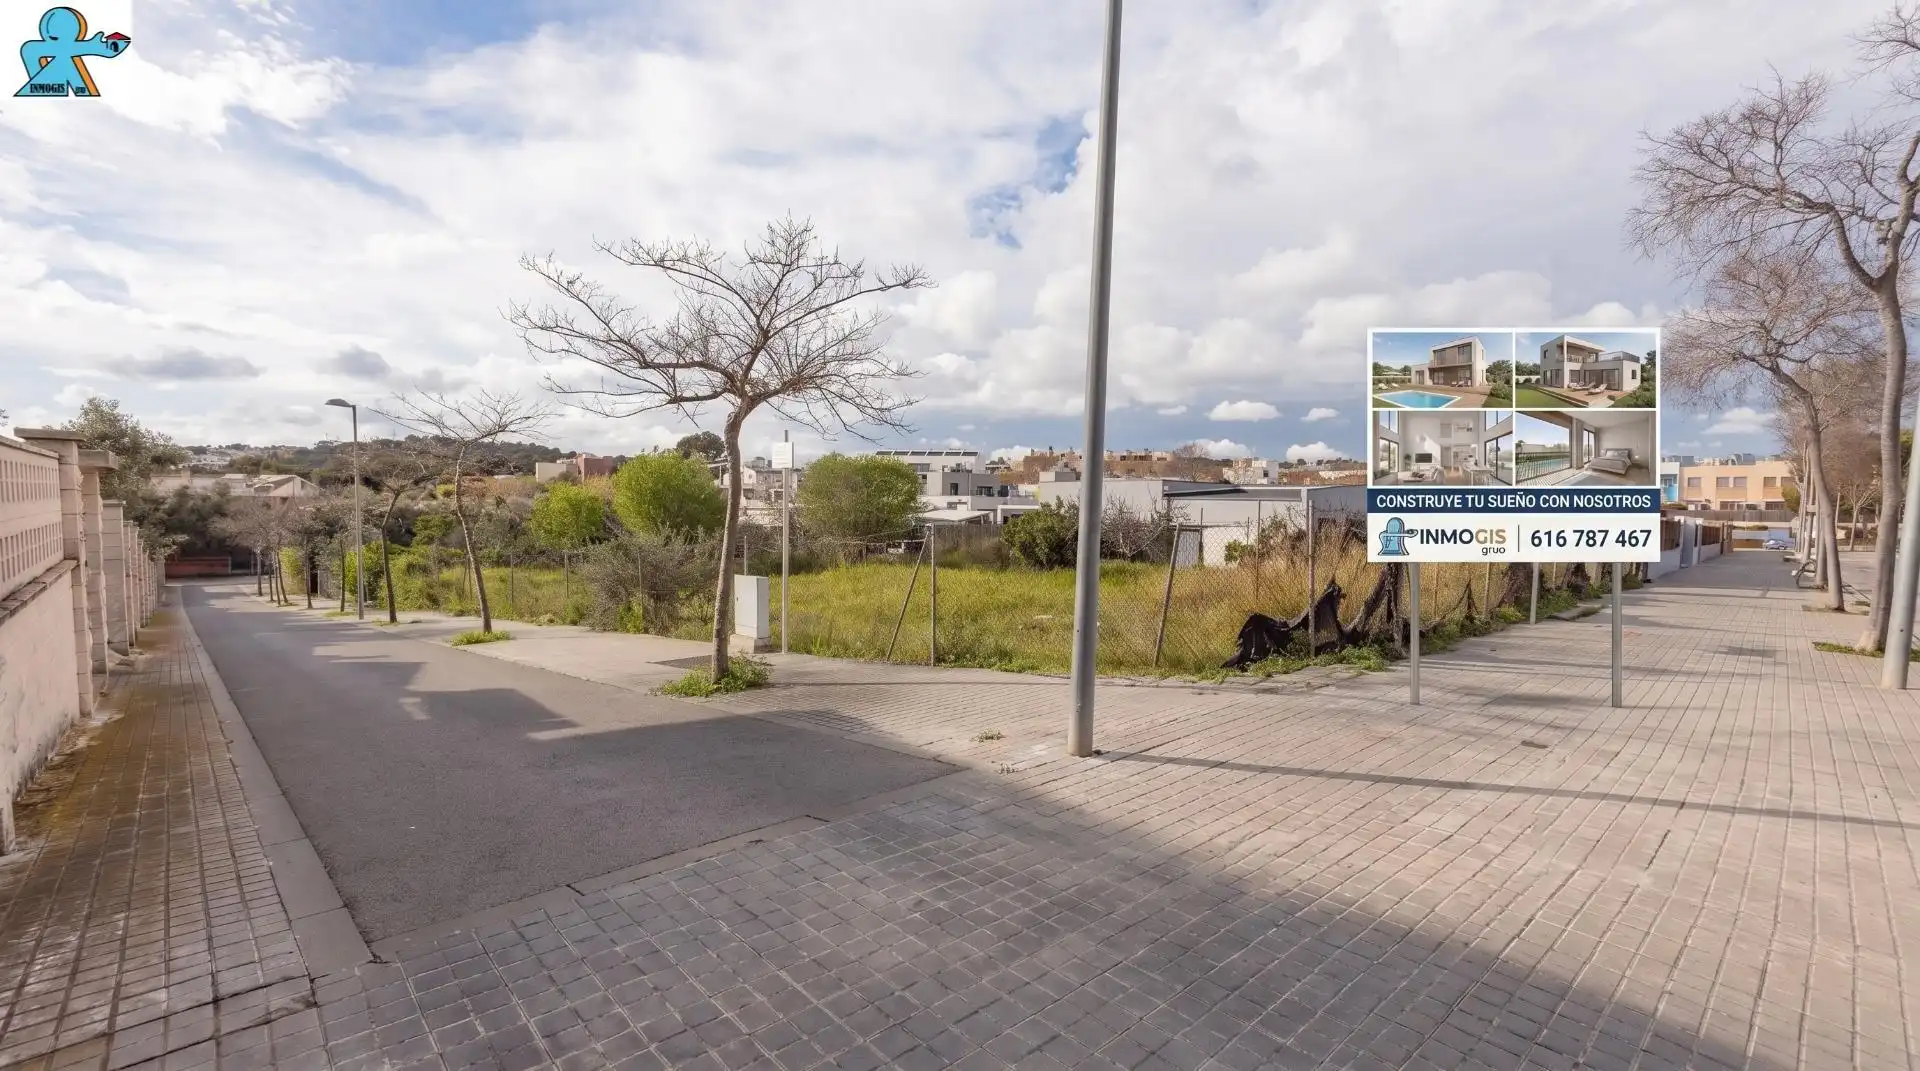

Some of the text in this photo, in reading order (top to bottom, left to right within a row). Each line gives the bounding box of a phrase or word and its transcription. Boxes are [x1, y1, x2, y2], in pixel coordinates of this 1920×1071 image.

[1376, 491, 1651, 508] CONSTRUYE TU SUEÑO CON NOSOTROS
[1419, 528, 1507, 545] INMOGIS
[1530, 530, 1652, 548] 616 787 467
[1481, 547, 1506, 556] gruo
